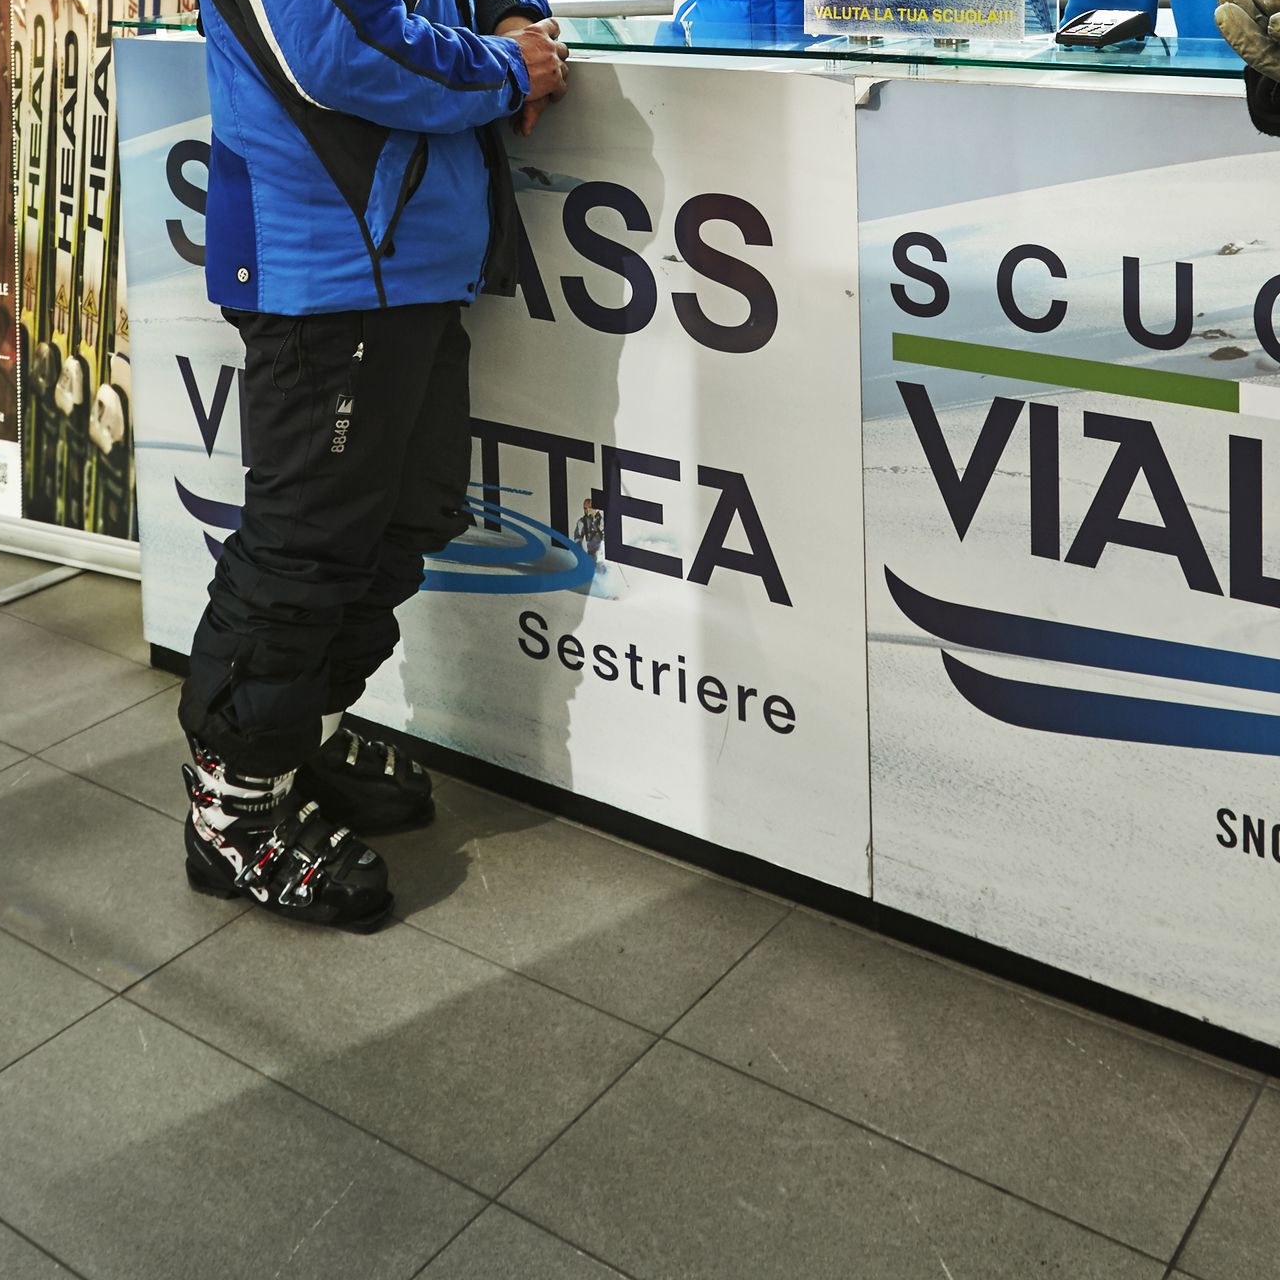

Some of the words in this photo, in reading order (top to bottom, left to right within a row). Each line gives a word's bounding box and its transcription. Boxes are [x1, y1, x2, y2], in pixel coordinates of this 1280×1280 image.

[814, 6, 871, 21] VALUTA
[873, 8, 894, 22] LA
[897, 8, 929, 22] TUA
[932, 9, 1015, 24] SCUOLA!!!
[27, 14, 46, 220] HEAD
[58, 29, 79, 254] HEAD
[331, 419, 350, 453] 8848
[518, 609, 796, 735] Sestriere
